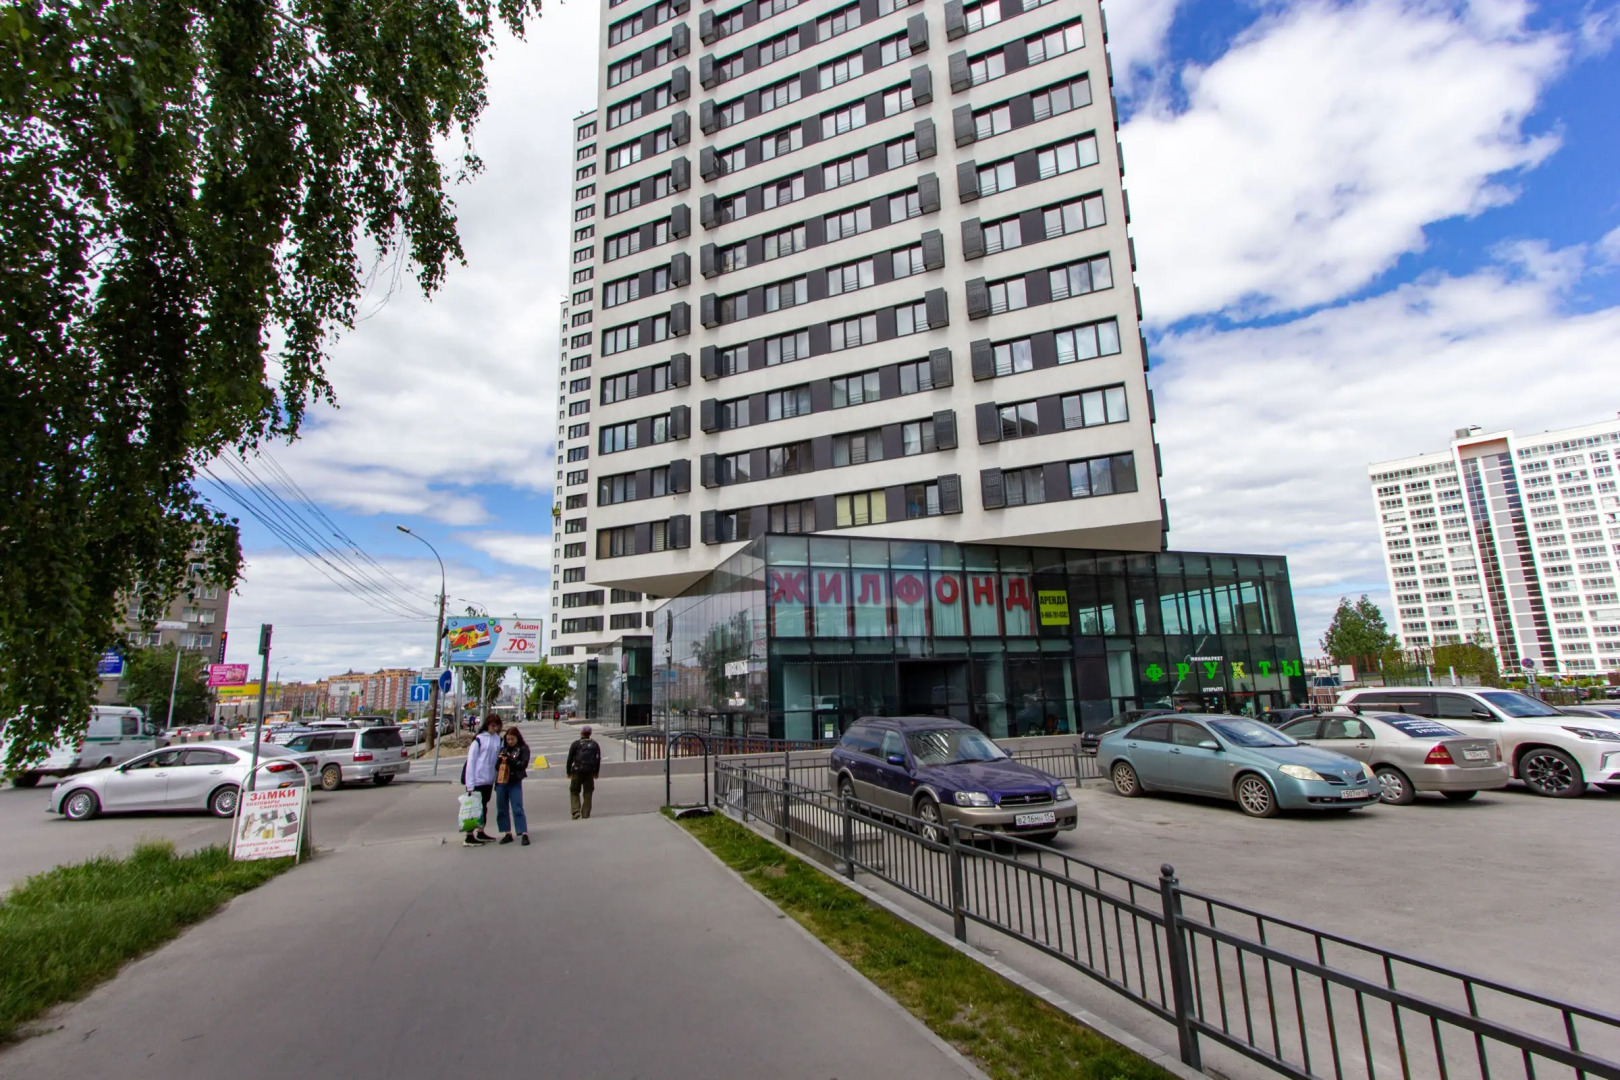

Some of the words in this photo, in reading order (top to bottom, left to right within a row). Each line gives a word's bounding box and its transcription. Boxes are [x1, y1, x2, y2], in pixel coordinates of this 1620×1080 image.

[771, 572, 1031, 611] ЖИЛФОНД
[1040, 595, 1067, 605] АРЕНДА
[509, 638, 535, 651] 70%
[1146, 660, 1301, 682] ФРУКТЫ
[250, 789, 296, 801] ЗАМКИ
